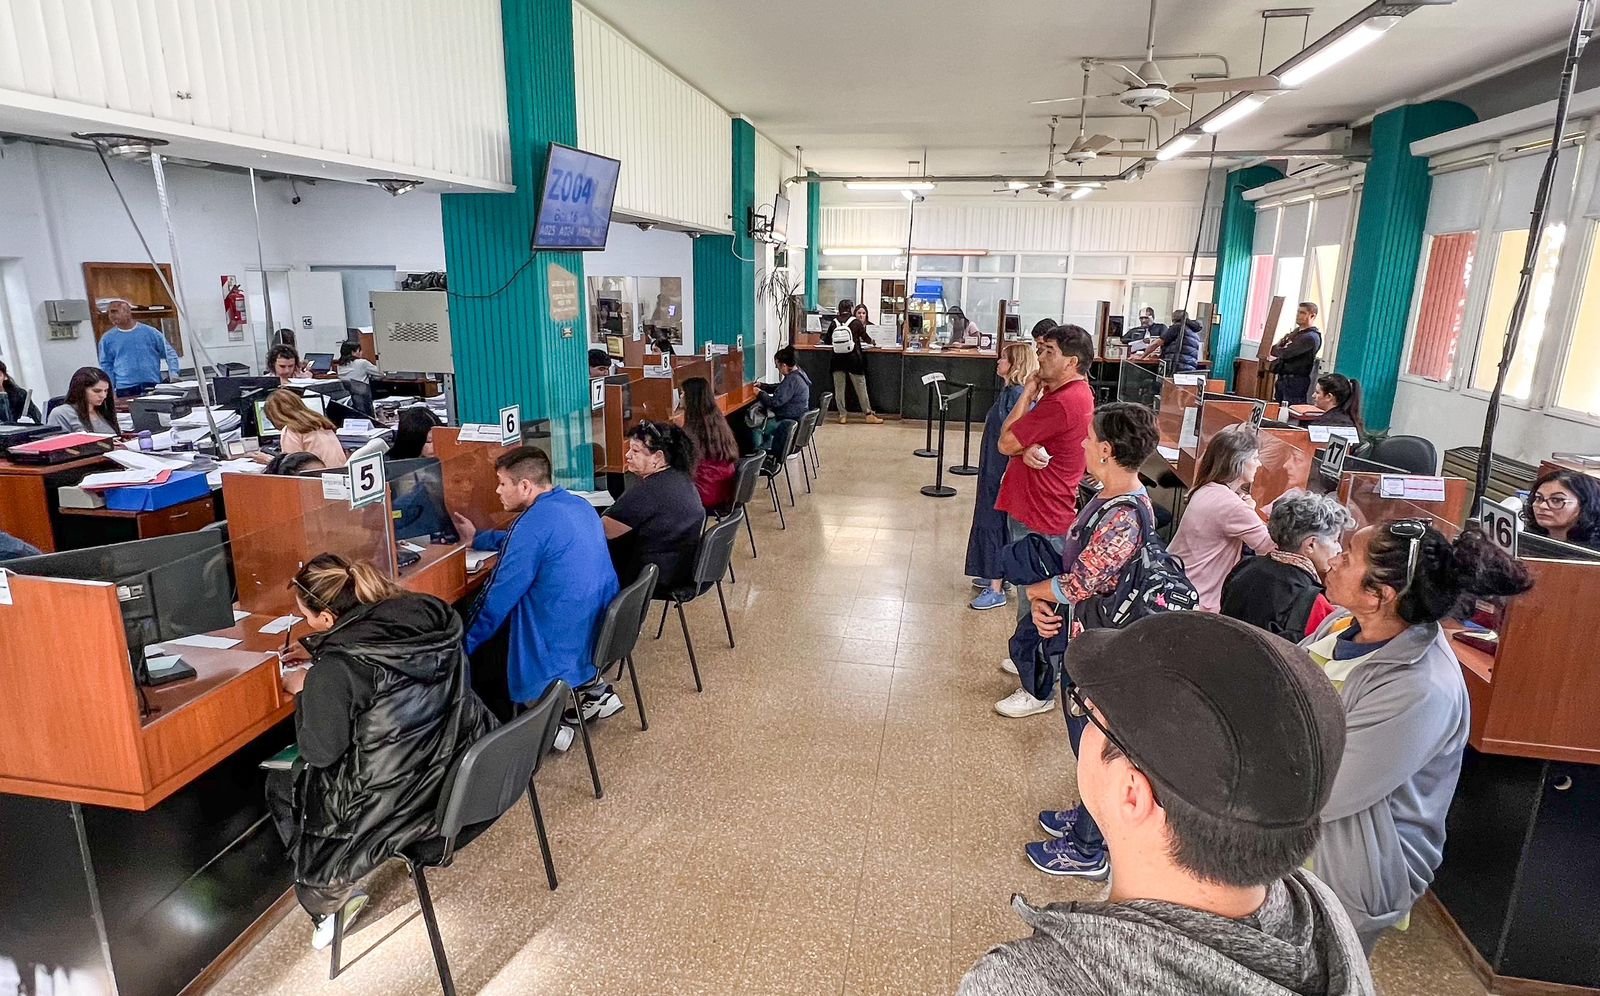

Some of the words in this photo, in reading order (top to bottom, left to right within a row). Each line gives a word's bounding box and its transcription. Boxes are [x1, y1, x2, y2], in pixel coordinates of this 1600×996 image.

[547, 168, 593, 203] Z004
[663, 356, 668, 368] 8
[596, 385, 602, 400] 7
[506, 413, 515, 433] 6
[1328, 441, 1344, 464] 17
[361, 463, 375, 491] 5
[1484, 511, 1512, 548] 16
